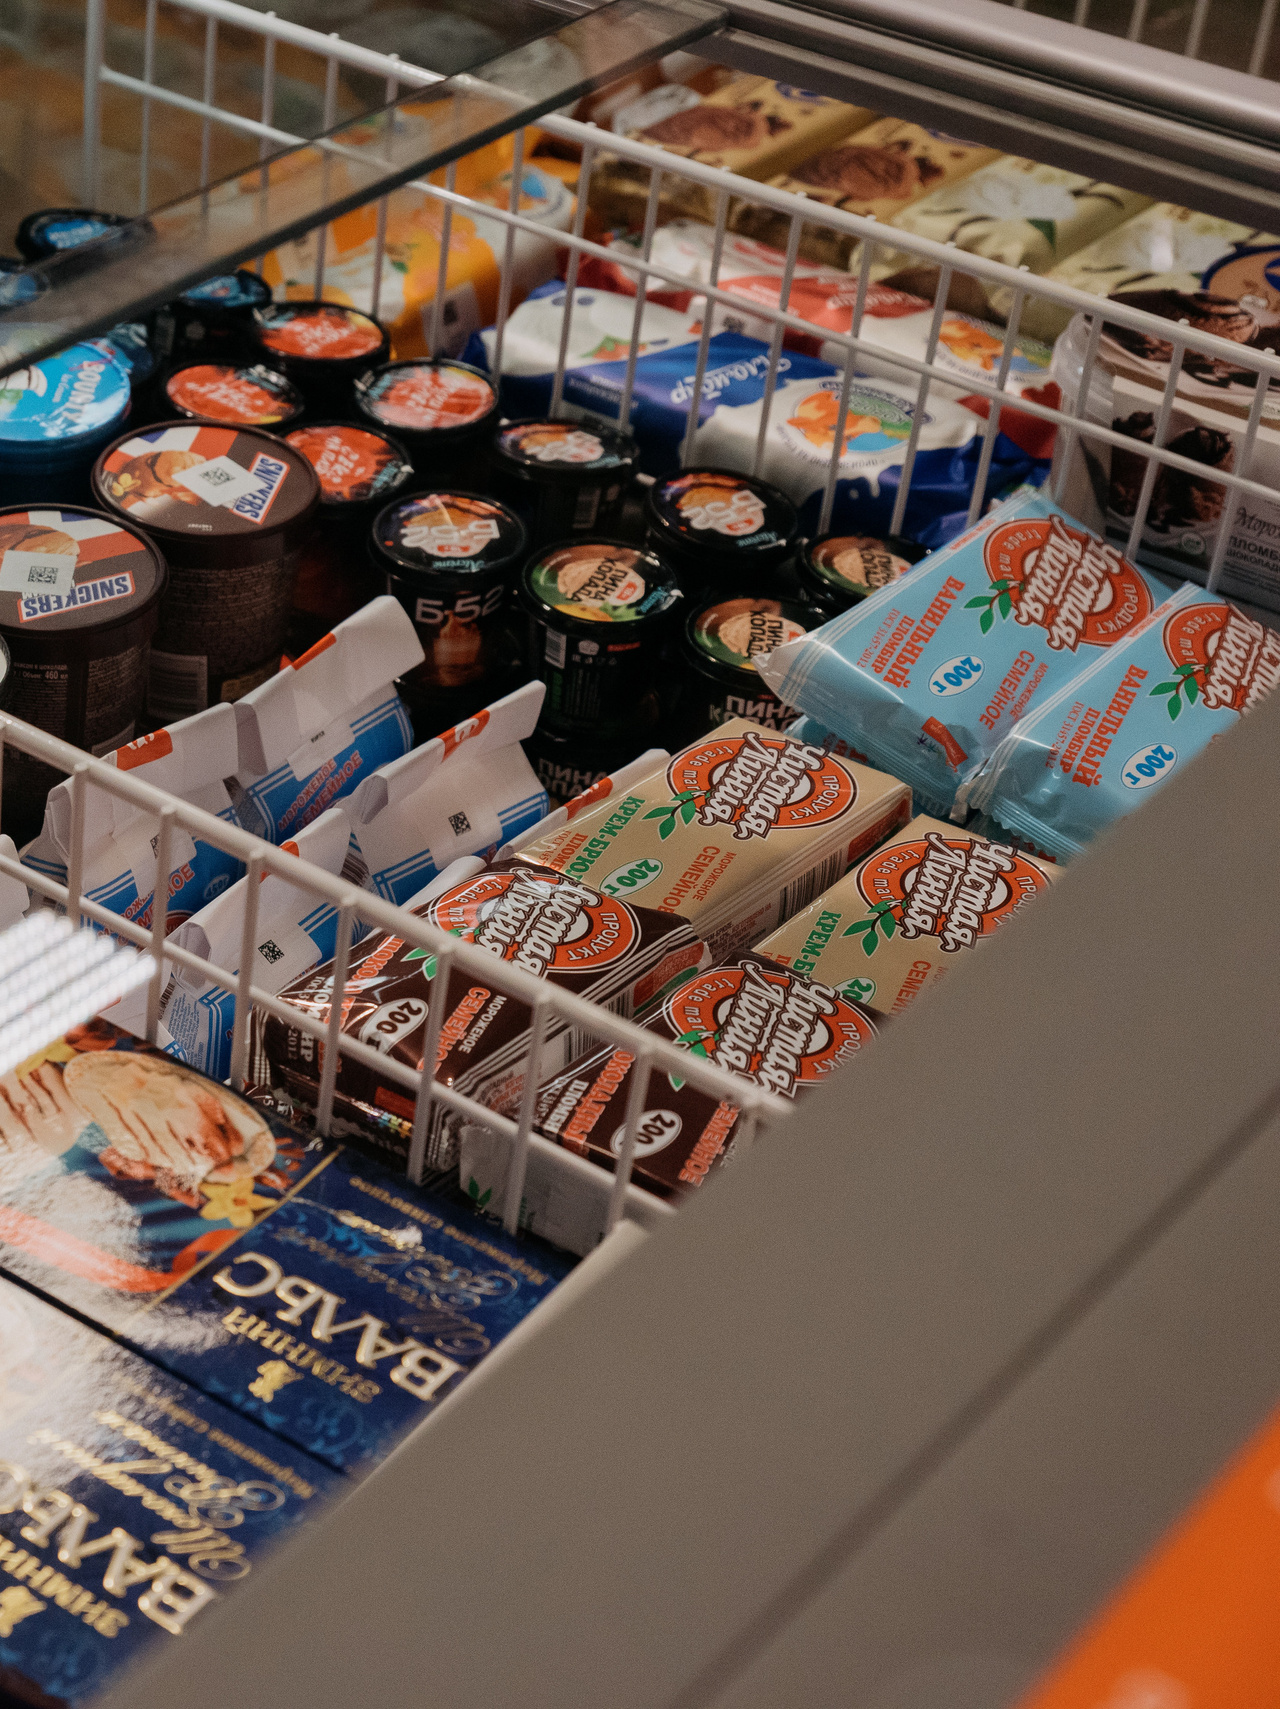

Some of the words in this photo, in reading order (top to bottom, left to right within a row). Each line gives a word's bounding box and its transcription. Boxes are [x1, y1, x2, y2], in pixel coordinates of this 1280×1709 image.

[1003, 528, 1042, 550] trade
[601, 568, 629, 603] ПИНА
[1096, 582, 1139, 635] ПРОДУКТ
[870, 615, 916, 674] ПЛОМБИР
[883, 575, 965, 689] ВАНИЛЬНЫЙ
[1181, 611, 1223, 634] trade
[943, 656, 982, 687] 200
[979, 650, 1036, 731] СЕМЕЙНОЕ
[1010, 662, 1049, 721] МОРОЖЕНОЕ
[1059, 706, 1102, 774] ПЛОМБИР
[1072, 664, 1148, 788] ВАНИЛЬНЫЙ
[690, 745, 734, 767] trade
[1134, 744, 1175, 778] 200
[277, 758, 337, 832] МОРОЖЕНОЕ
[789, 774, 840, 821] ПРОДУКТ
[568, 795, 646, 882] КРЕМ-БРЮЛ
[875, 849, 916, 874] trade
[453, 880, 503, 905] trade
[615, 858, 660, 888] 200
[691, 852, 738, 902] МОРОЖЕНОЕ
[568, 912, 619, 962] ПРОДУКТ
[687, 977, 735, 1003] trade
[845, 977, 874, 1001] 20
[375, 1000, 424, 1035] 200
[458, 994, 508, 1055] МОРОЖЕНОЕ
[812, 1021, 862, 1074] ПРОДУКТ
[212, 1251, 470, 1402] ВАЛЬС
